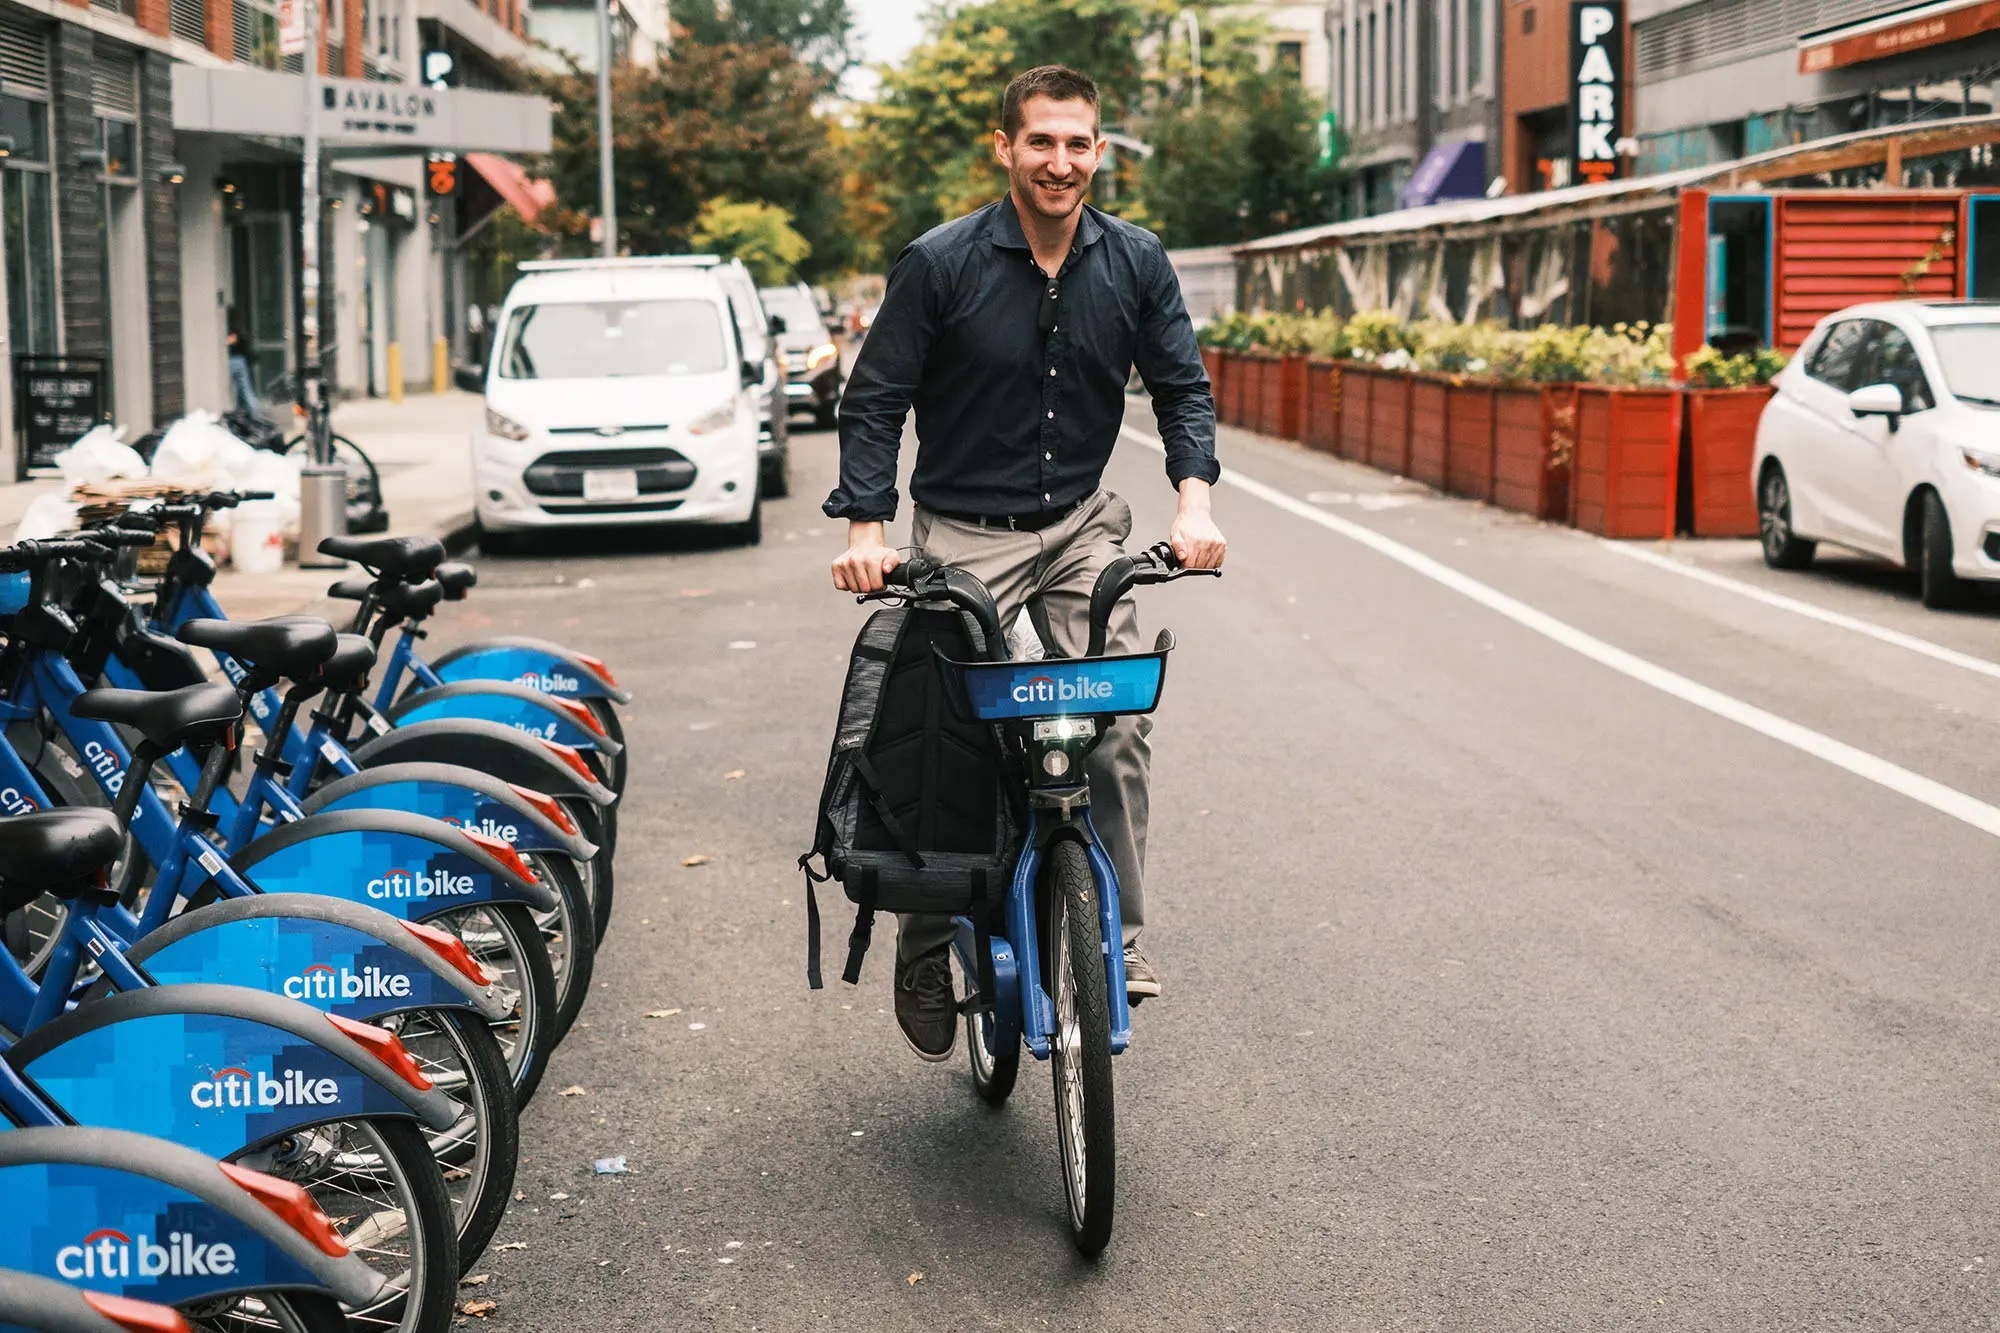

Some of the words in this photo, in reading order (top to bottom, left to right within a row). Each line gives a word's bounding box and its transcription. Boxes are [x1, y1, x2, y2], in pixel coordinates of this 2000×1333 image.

[1577, 6, 1615, 160] PARK
[344, 88, 435, 117] AVALON
[541, 673, 579, 693] bike
[1012, 675, 1054, 703] citi
[1058, 675, 1113, 701] bike
[84, 741, 120, 778] citi
[0, 787, 39, 816] cit
[367, 868, 412, 899] citi
[415, 869, 474, 897] bike
[283, 963, 336, 999] citi
[341, 965, 411, 998] bike
[190, 1067, 253, 1108] citi
[257, 1068, 339, 1106] bike
[55, 1228, 132, 1279] citi
[137, 1231, 236, 1277] bike
